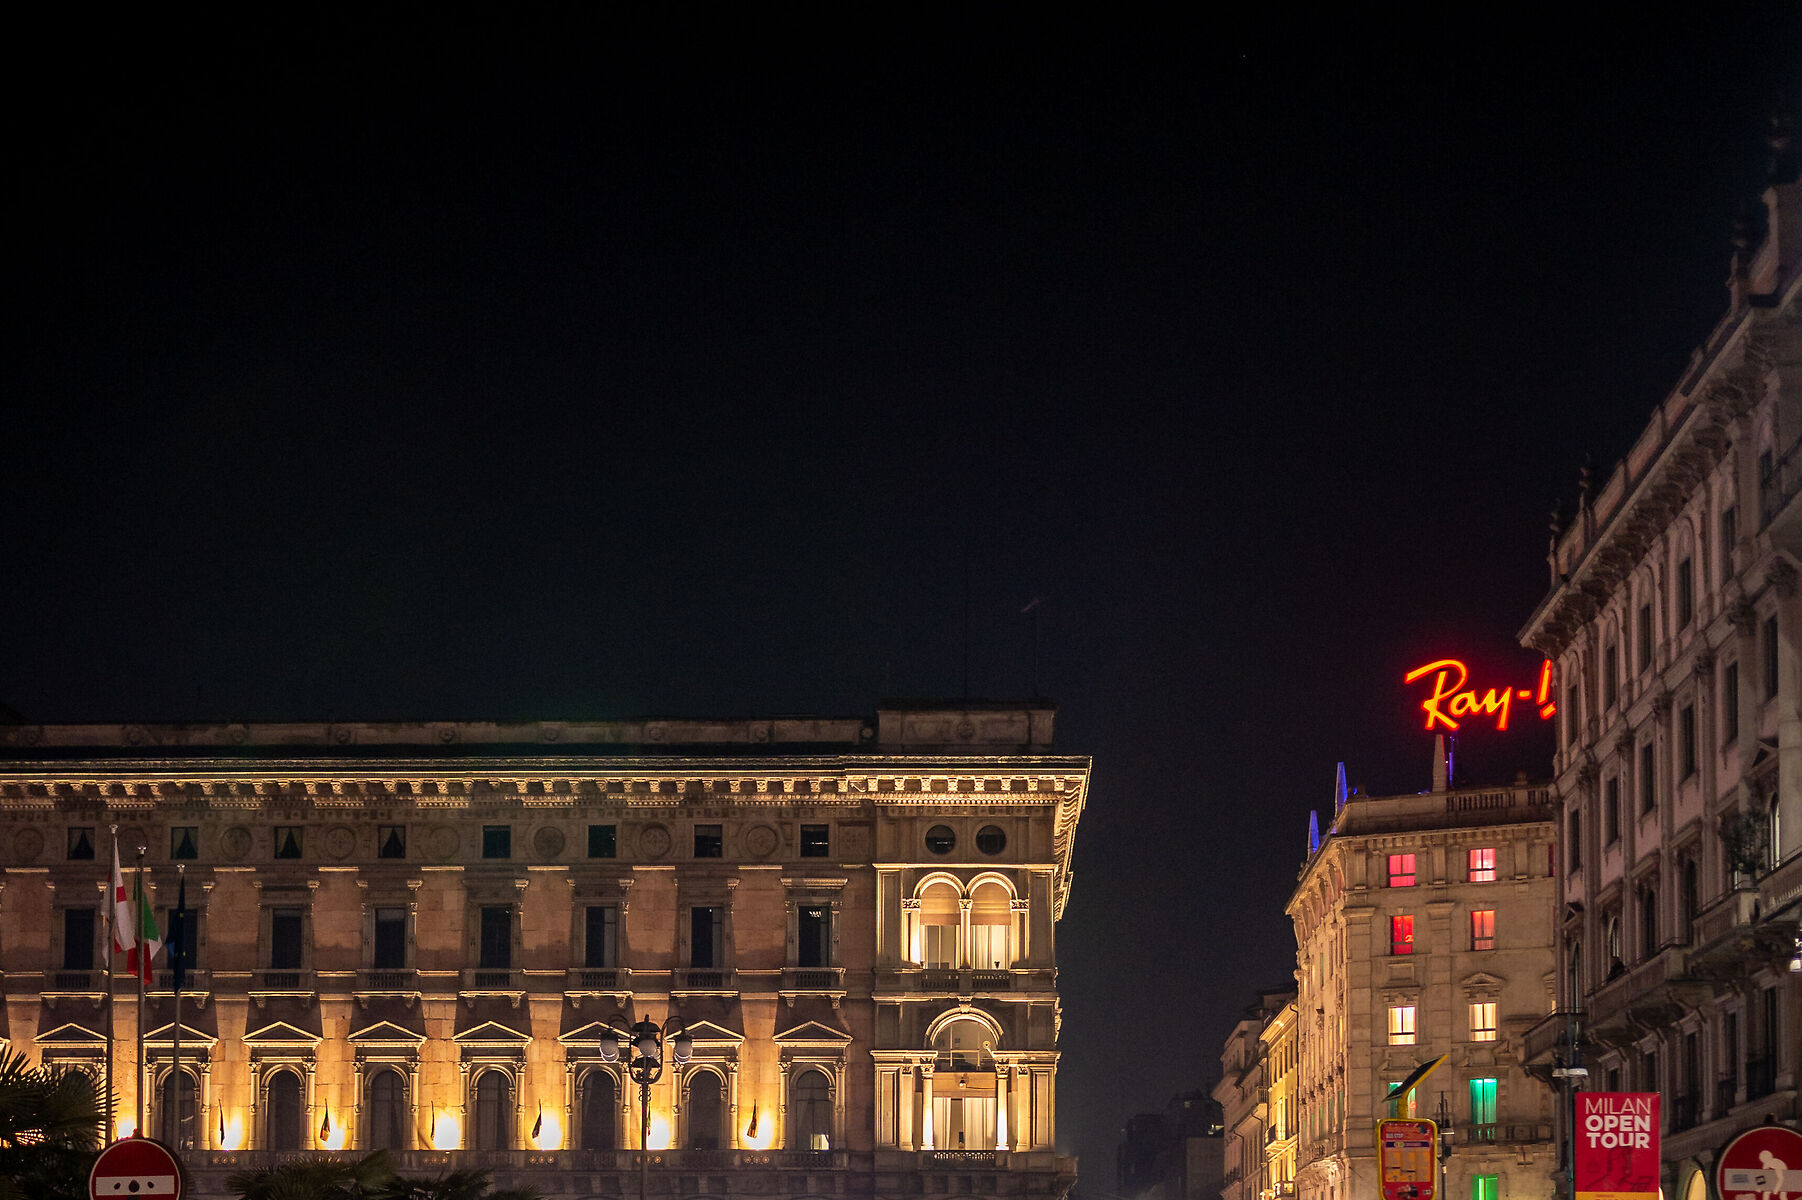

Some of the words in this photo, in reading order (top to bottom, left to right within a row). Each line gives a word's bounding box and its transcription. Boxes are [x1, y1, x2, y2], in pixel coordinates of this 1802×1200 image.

[1585, 1097, 1652, 1114] MILAN
[1585, 1114, 1651, 1132] OPEN
[1586, 1132, 1650, 1149] TOUR
